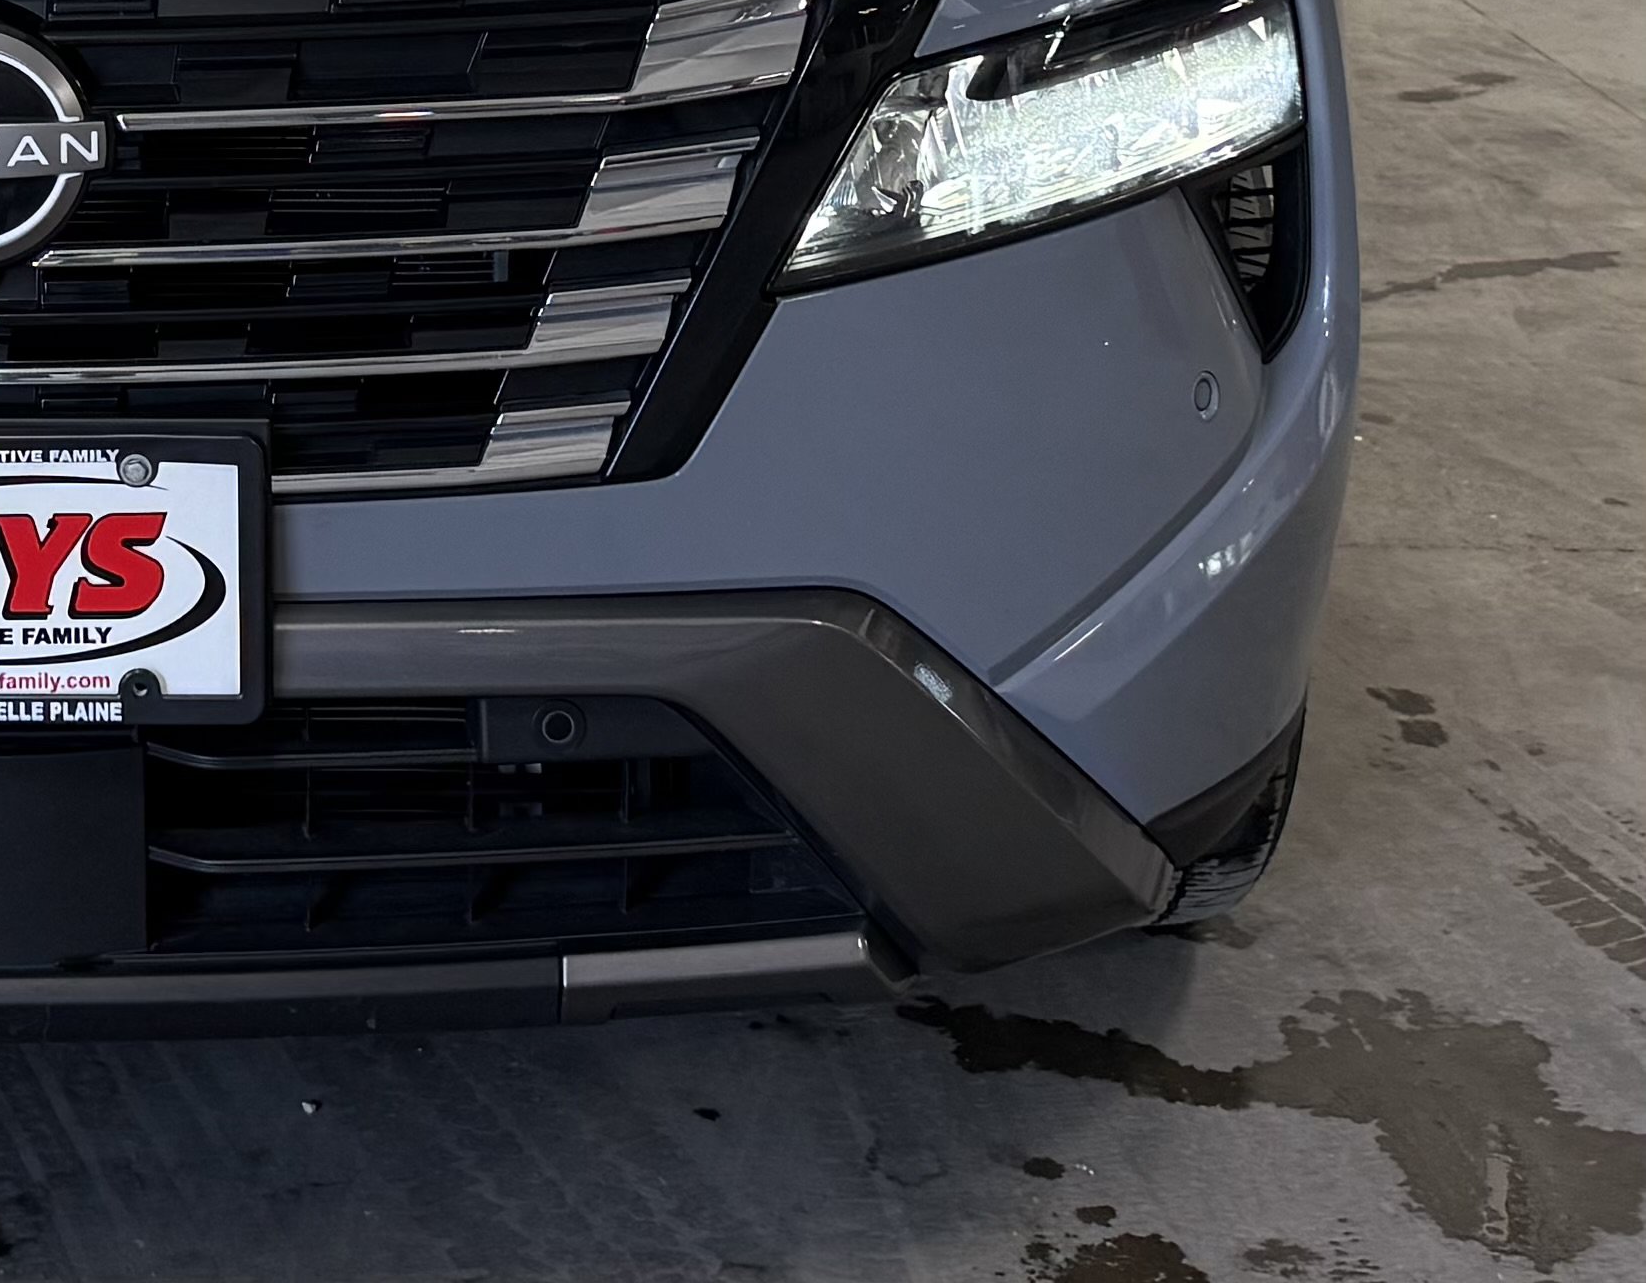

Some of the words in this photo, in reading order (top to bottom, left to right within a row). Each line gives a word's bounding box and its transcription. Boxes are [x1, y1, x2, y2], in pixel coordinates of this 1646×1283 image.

[49, 448, 120, 463] FAMILY
[22, 626, 113, 645] FAMILY
[49, 701, 123, 722] PLAINE
